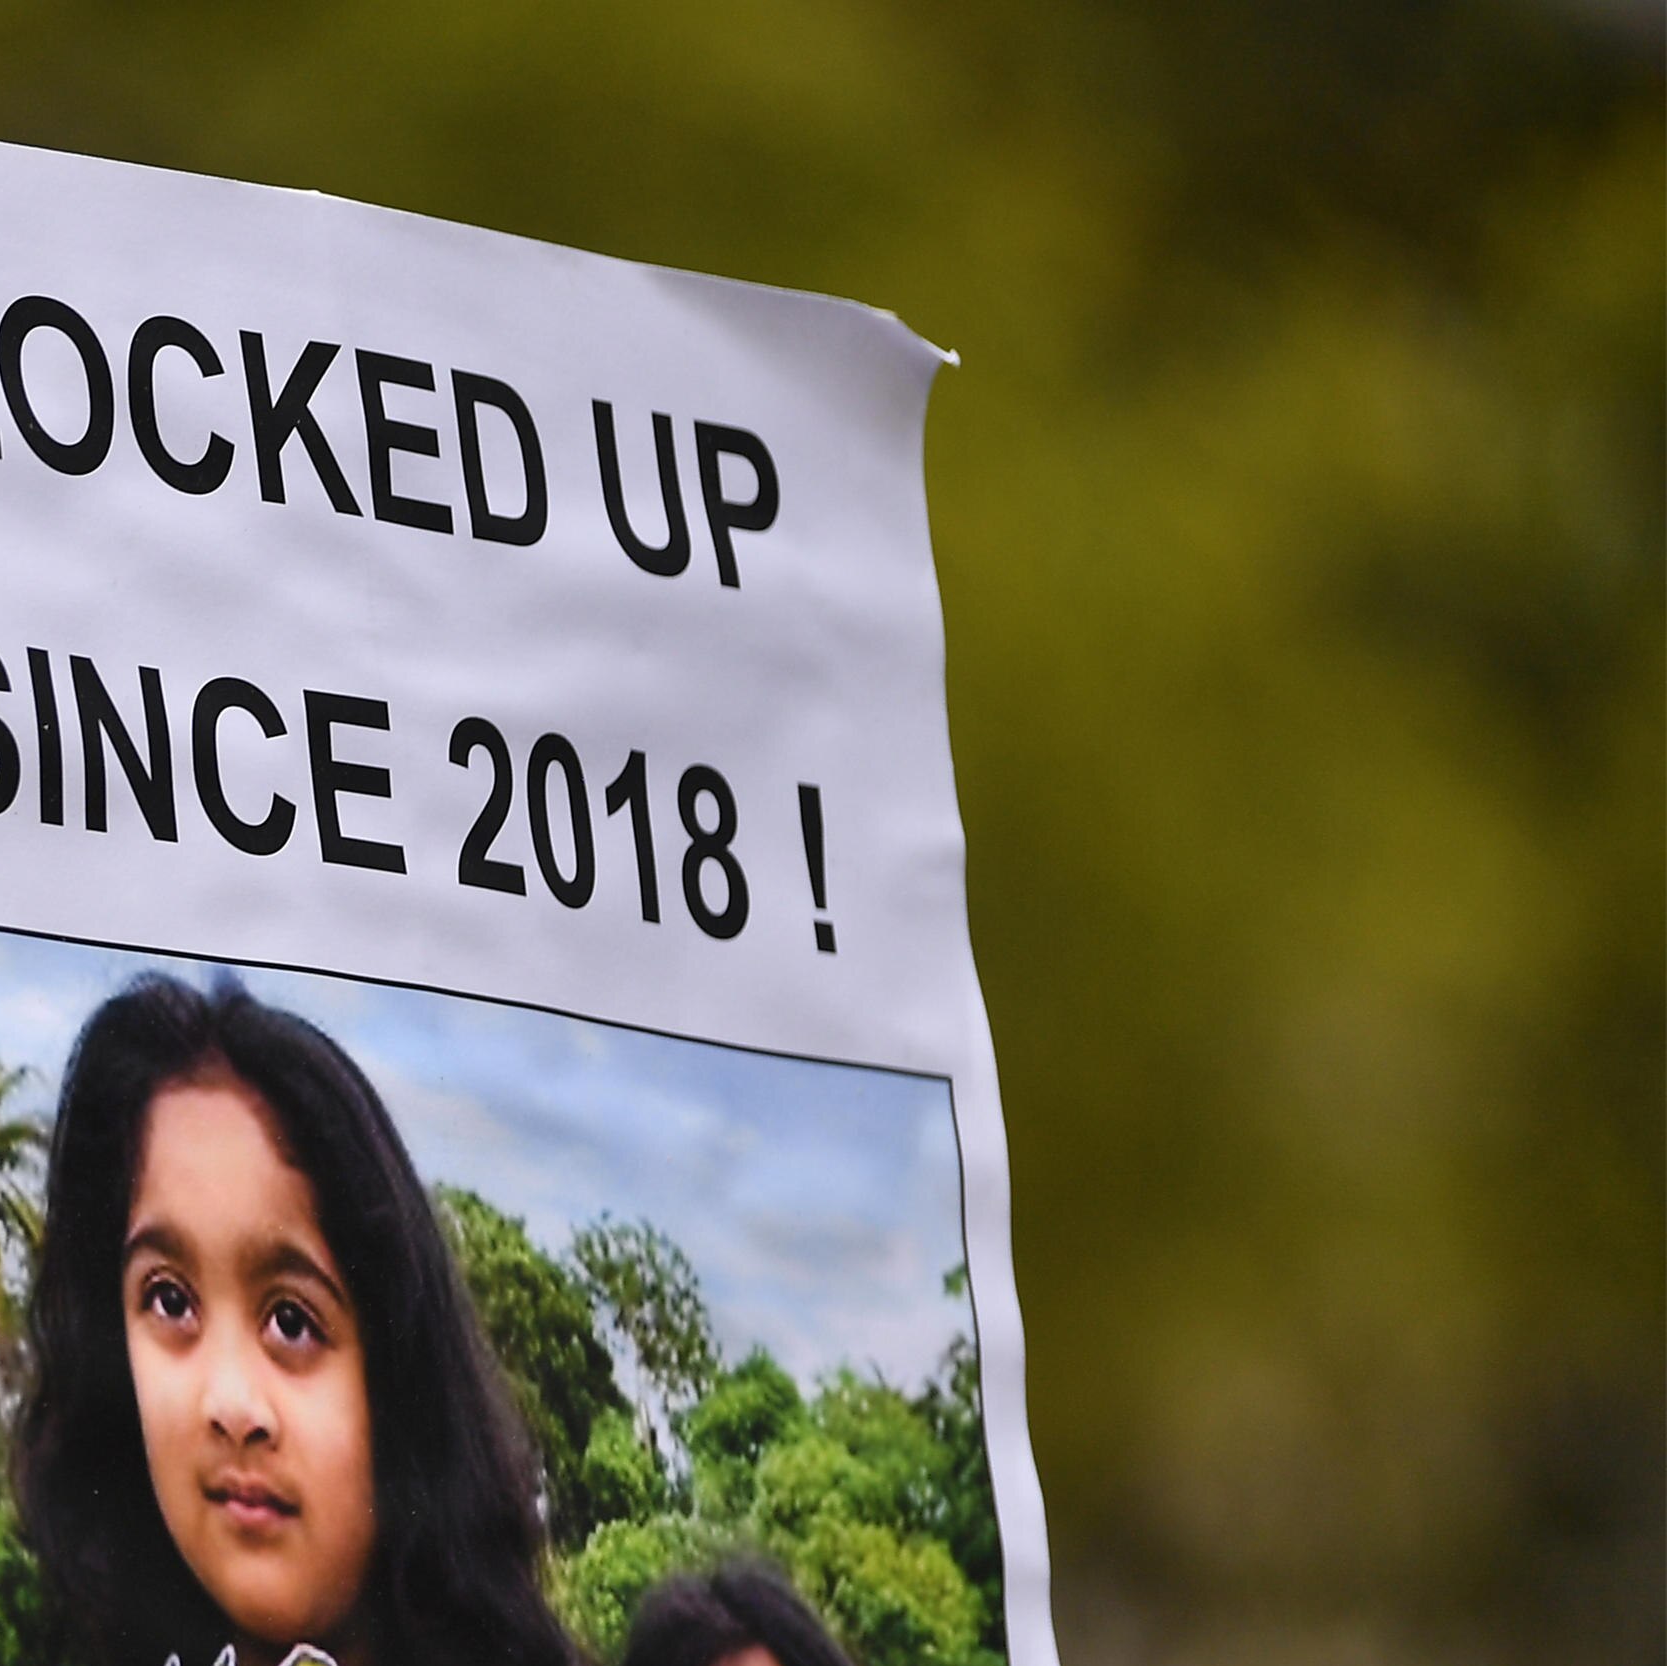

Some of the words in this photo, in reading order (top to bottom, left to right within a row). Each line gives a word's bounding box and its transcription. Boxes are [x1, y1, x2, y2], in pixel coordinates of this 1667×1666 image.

[591, 398, 780, 589] UP
[448, 716, 750, 941] 2018
[797, 783, 837, 954] !
